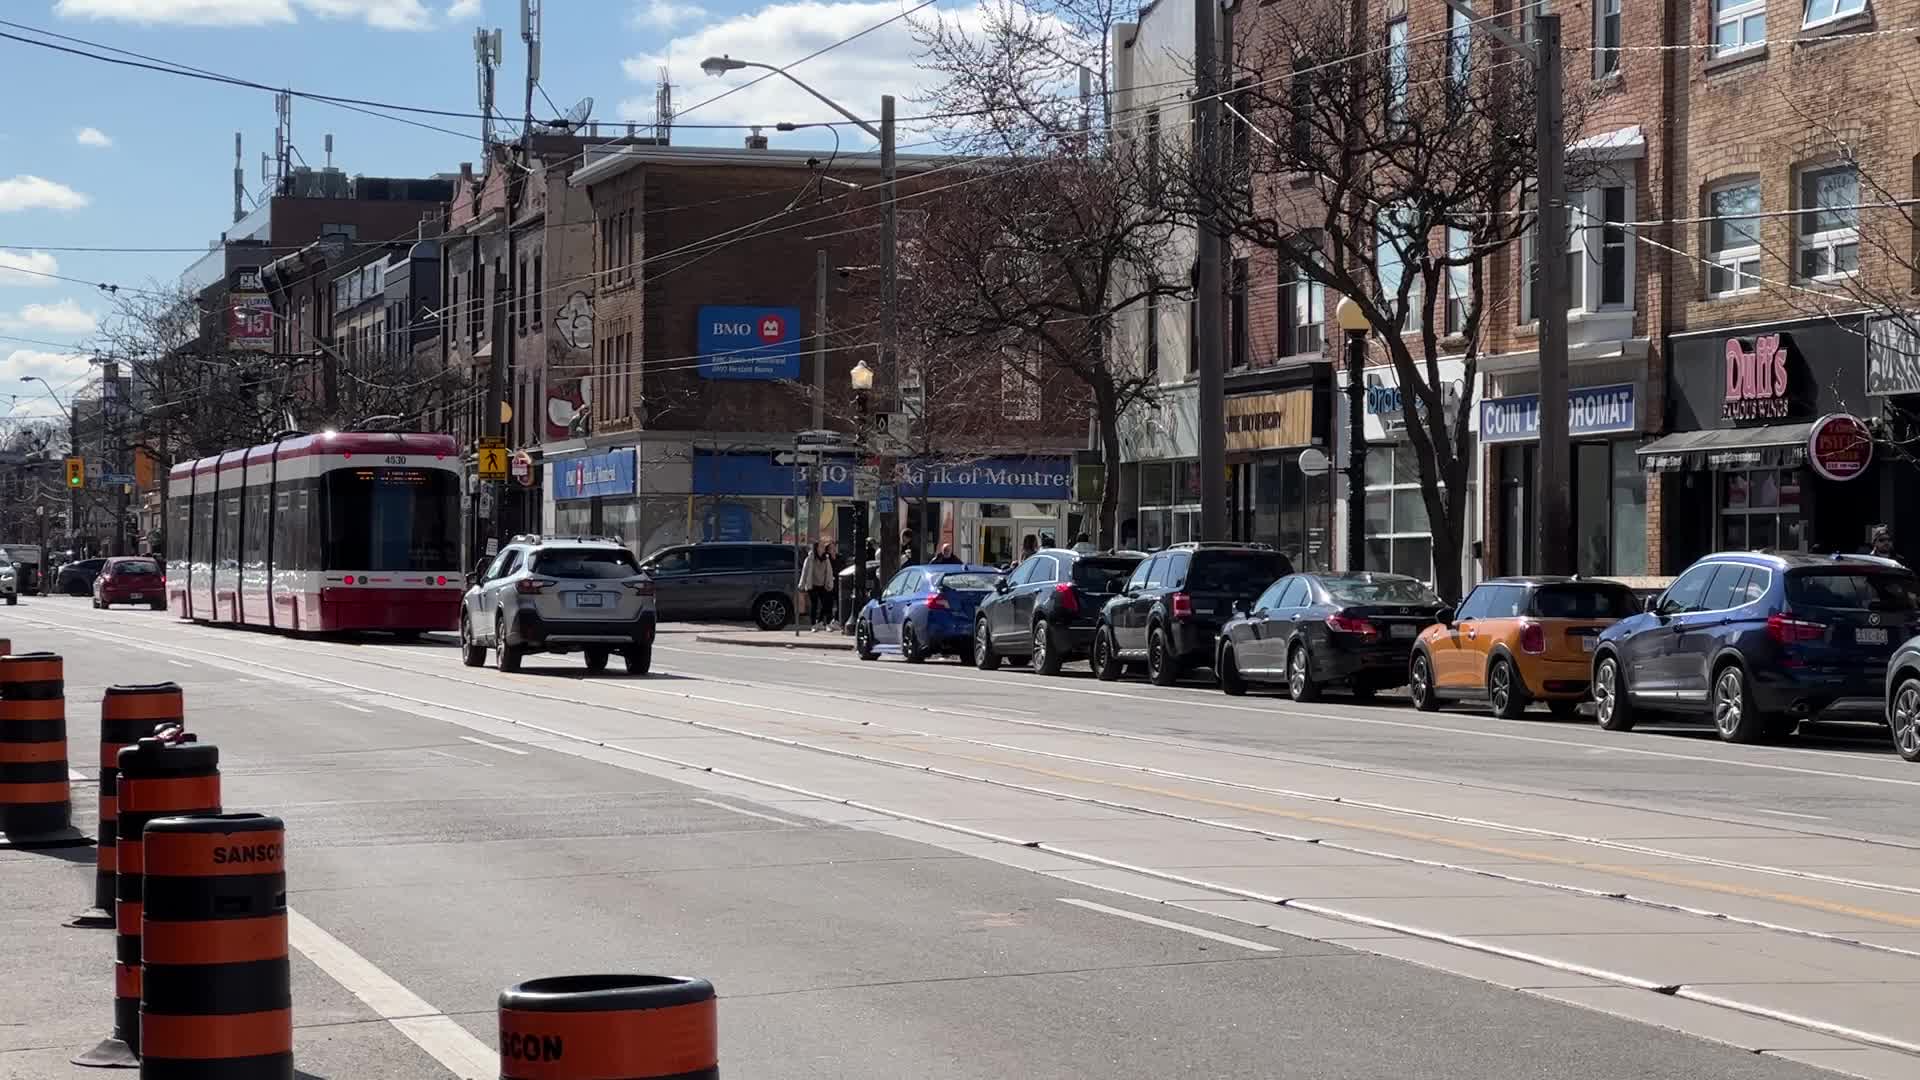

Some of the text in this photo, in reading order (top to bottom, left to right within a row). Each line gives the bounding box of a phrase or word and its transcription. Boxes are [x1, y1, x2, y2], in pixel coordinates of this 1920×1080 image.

[712, 323, 752, 336] BMO
[1725, 333, 1788, 400] Duff's
[1486, 403, 1520, 434] COIN
[959, 467, 981, 485] of
